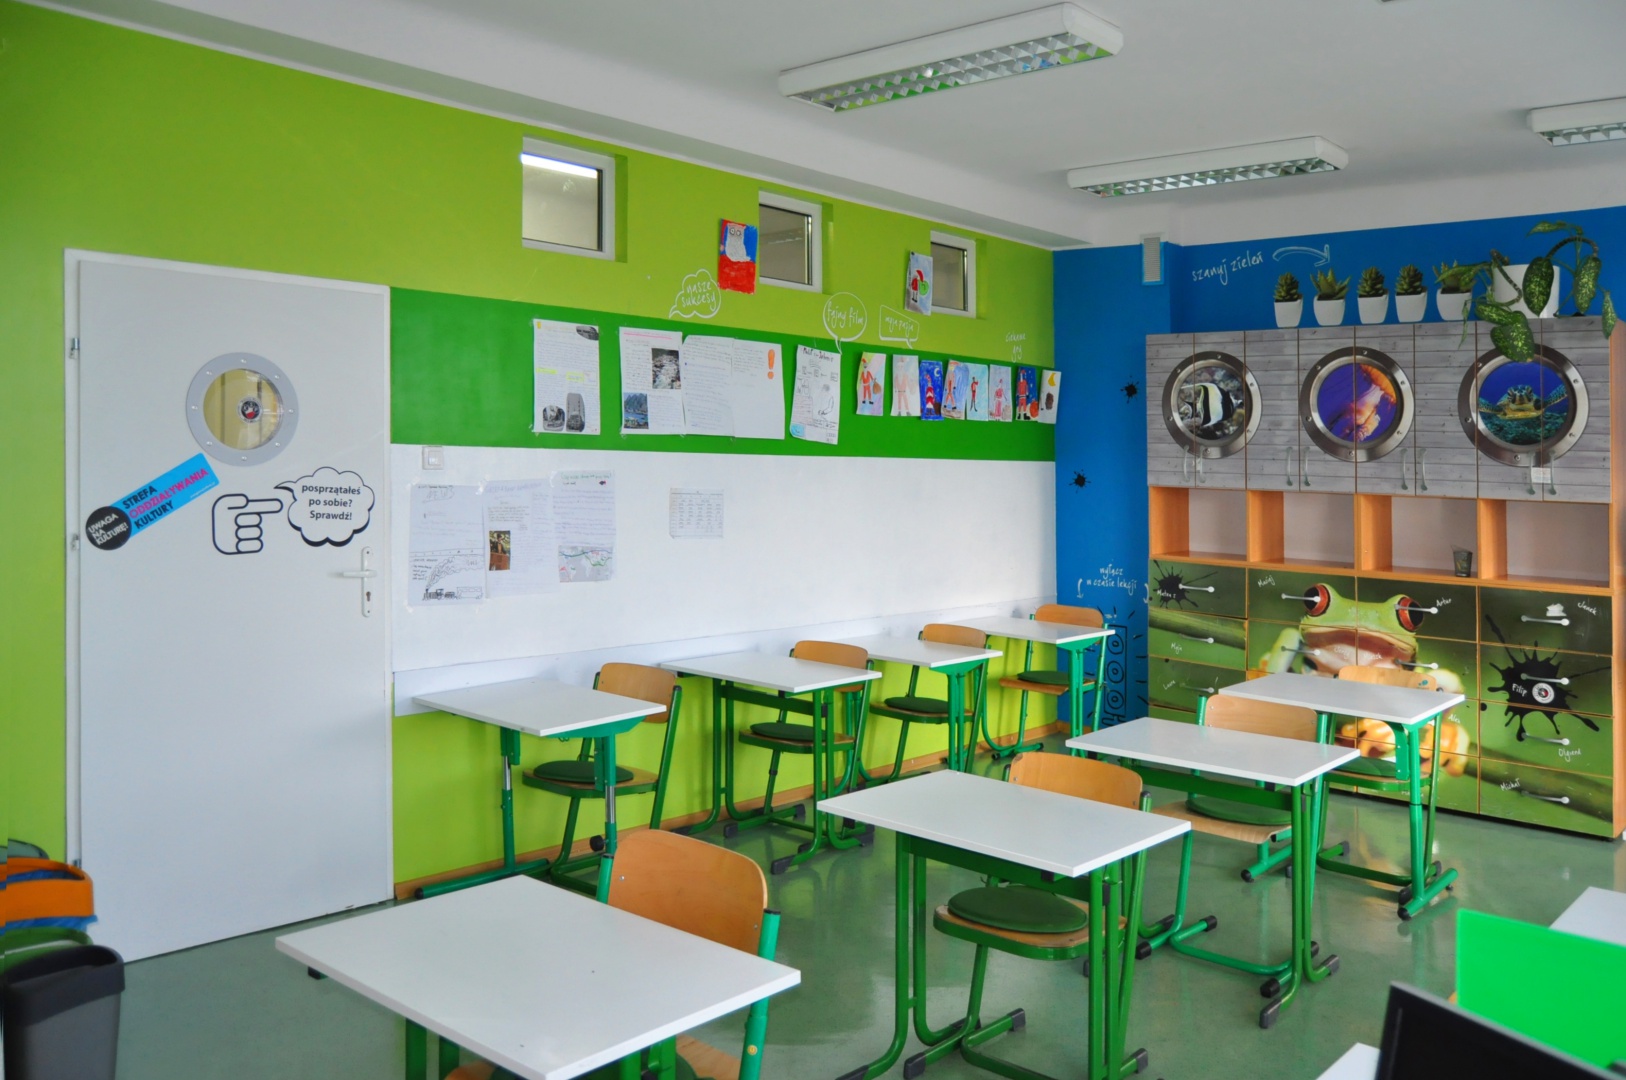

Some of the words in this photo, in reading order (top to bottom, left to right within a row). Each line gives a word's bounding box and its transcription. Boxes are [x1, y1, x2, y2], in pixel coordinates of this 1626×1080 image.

[1192, 257, 1228, 285] szanuj
[1230, 250, 1263, 271] zieleń
[687, 281, 711, 293] nasze
[682, 290, 716, 311] sukcesy
[827, 300, 846, 328] fajny
[849, 306, 863, 327] film
[123, 485, 157, 509] STREFA
[129, 468, 209, 518] ODDZIAŁYWANIA
[302, 485, 360, 495] posprzątałeś
[309, 499, 321, 507] po
[323, 498, 352, 507] sobie?
[88, 513, 119, 533] UWAGA
[134, 500, 174, 529] KULTURY
[310, 510, 352, 521] Sprawdź!
[91, 529, 106, 539] NA
[1511, 683, 1528, 697] Filip
